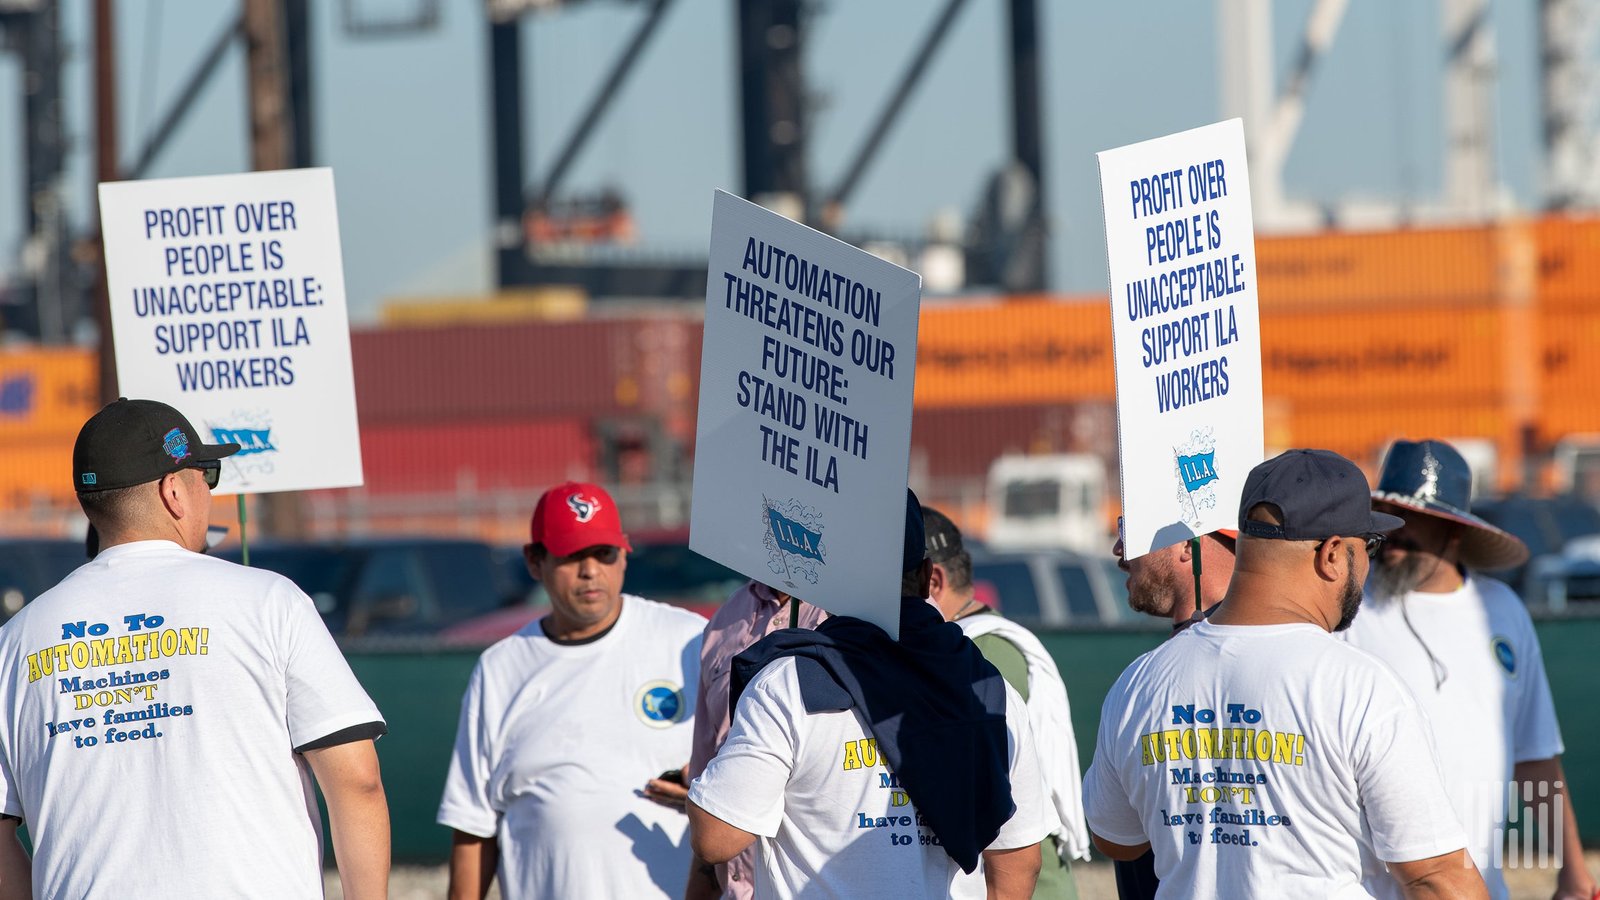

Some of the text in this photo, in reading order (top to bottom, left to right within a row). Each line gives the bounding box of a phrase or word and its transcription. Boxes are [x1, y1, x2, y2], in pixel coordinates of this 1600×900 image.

[1130, 159, 1227, 219] PROFIT OVER
[145, 201, 297, 239] PROFIT OVER
[1146, 209, 1221, 266] PEOPLE IS
[165, 240, 283, 276] PEOPLE IS
[133, 277, 323, 318] UNACCEPTABLE:
[742, 236, 881, 327] AUTOMATION
[1126, 253, 1245, 321] UNACCEPTABLE:
[155, 317, 310, 355] SUPPORT ILA
[724, 272, 844, 356] THREATENS
[851, 329, 895, 380] OUR
[1142, 312, 1210, 368] SUPPORT
[1214, 305, 1239, 348] ILA
[176, 356, 294, 392] WORKERS
[762, 335, 849, 406] FUTURE:
[1155, 356, 1230, 414] WORKERS
[736, 370, 868, 460] STAND WITH
[760, 425, 839, 493] THE ILA
[1184, 459, 1214, 483] I.L.A.
[776, 520, 818, 555] I.L.A.
[61, 613, 165, 640] No To
[27, 627, 209, 683] AUTOMATION!
[58, 668, 170, 694] Machines
[74, 684, 158, 710] DON'T
[45, 702, 193, 738] have families
[1172, 704, 1261, 724] No To
[74, 723, 163, 749] to feed.
[1141, 728, 1305, 766] AUTOMATION!
[1170, 767, 1267, 785] Machines
[1184, 786, 1255, 804] DON'T
[858, 813, 912, 828] have
[1161, 807, 1291, 827] have families
[891, 833, 912, 846] to
[1210, 827, 1258, 847] feed.
